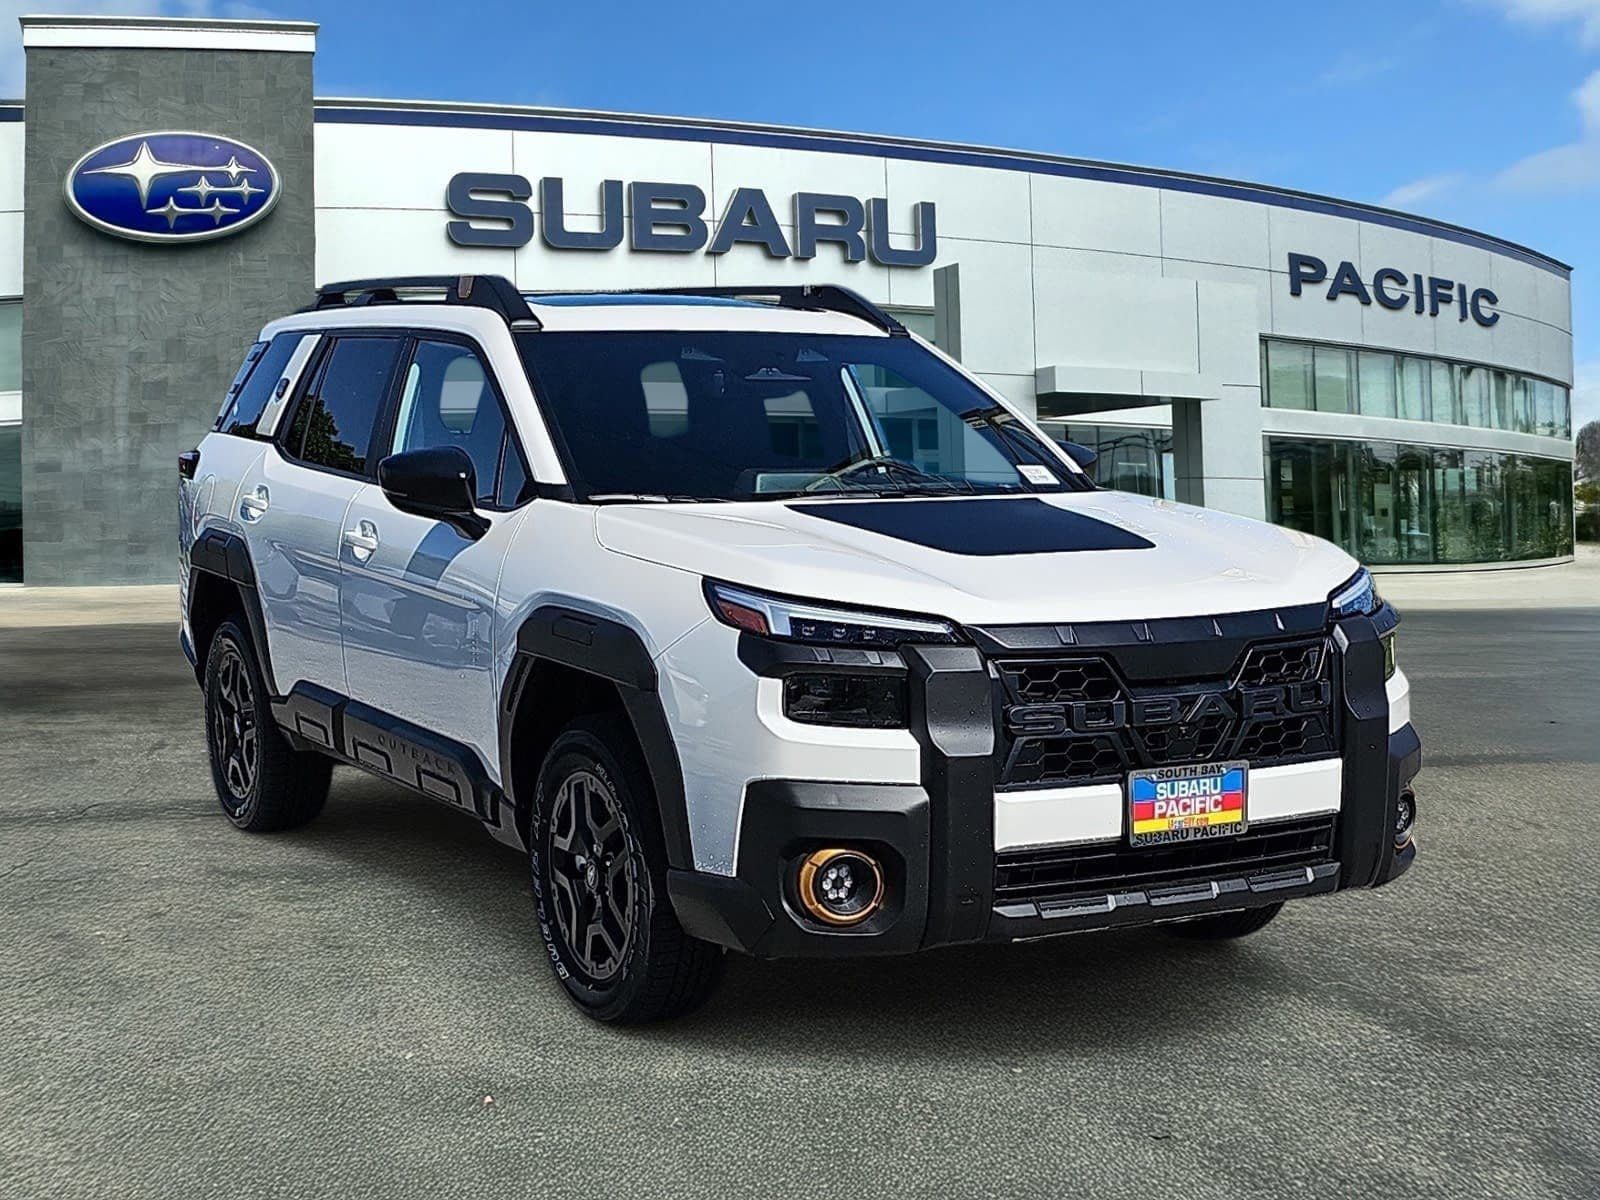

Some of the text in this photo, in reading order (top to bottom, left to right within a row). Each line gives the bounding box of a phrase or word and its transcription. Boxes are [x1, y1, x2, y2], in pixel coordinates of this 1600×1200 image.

[446, 172, 937, 267] SUBARU
[1288, 252, 1500, 327] PACIFIC
[1006, 680, 1331, 734] SUBARU
[378, 734, 455, 774] OUTBACK
[1156, 777, 1221, 799] SUBARU
[1157, 764, 1224, 780] SOUTH BAY
[1154, 795, 1222, 819] PACIFIC
[1135, 828, 1190, 846] SUBARU
[1194, 823, 1242, 839] PACIFIC
